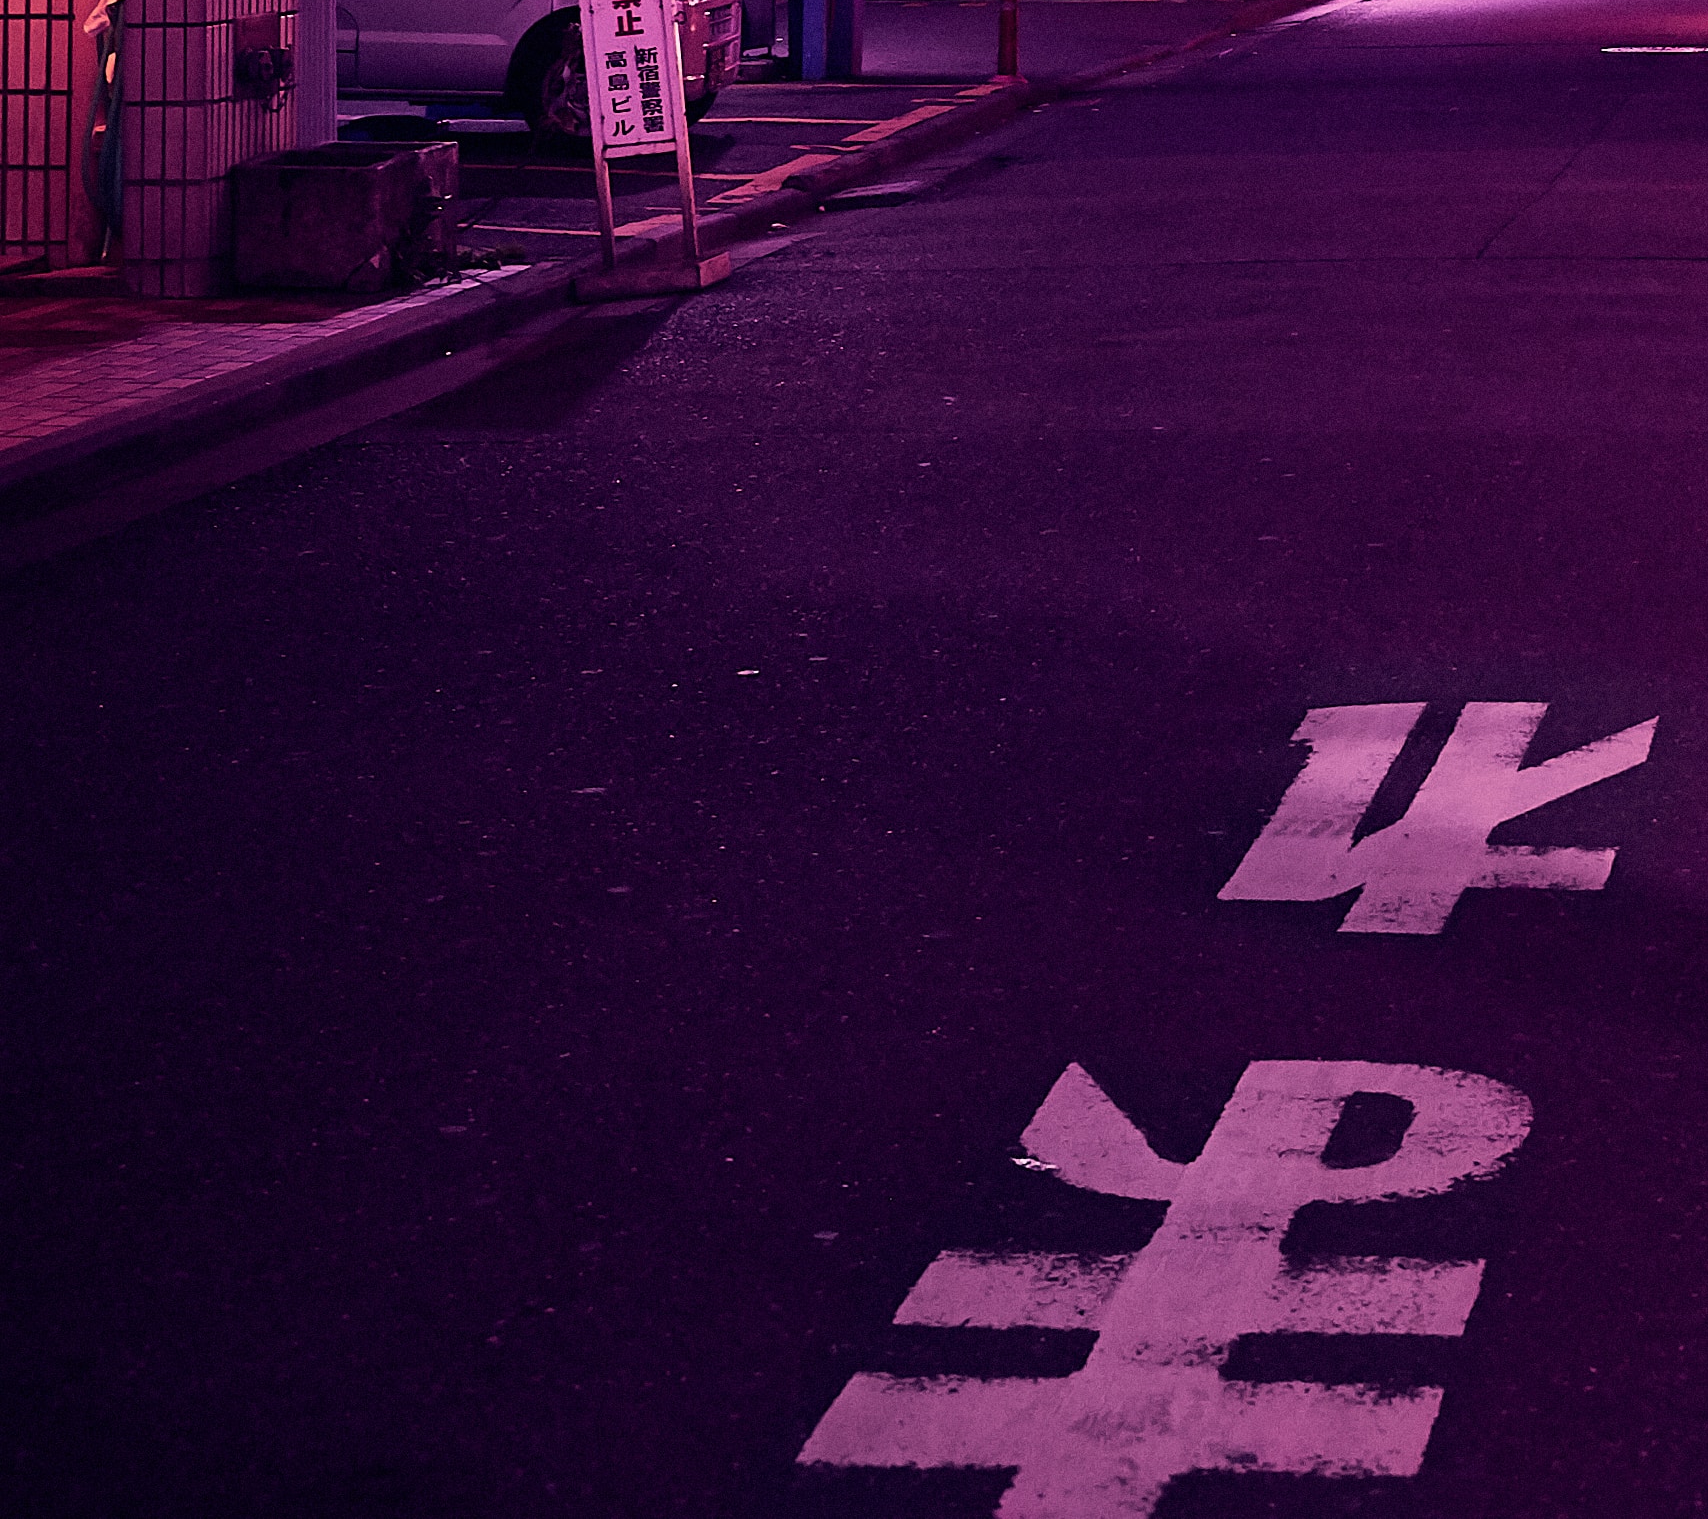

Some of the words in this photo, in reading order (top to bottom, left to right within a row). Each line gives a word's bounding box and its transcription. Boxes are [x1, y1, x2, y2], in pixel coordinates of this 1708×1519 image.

[604, 49, 636, 138] 高島ビル
[635, 46, 665, 134] 新宿警察署
